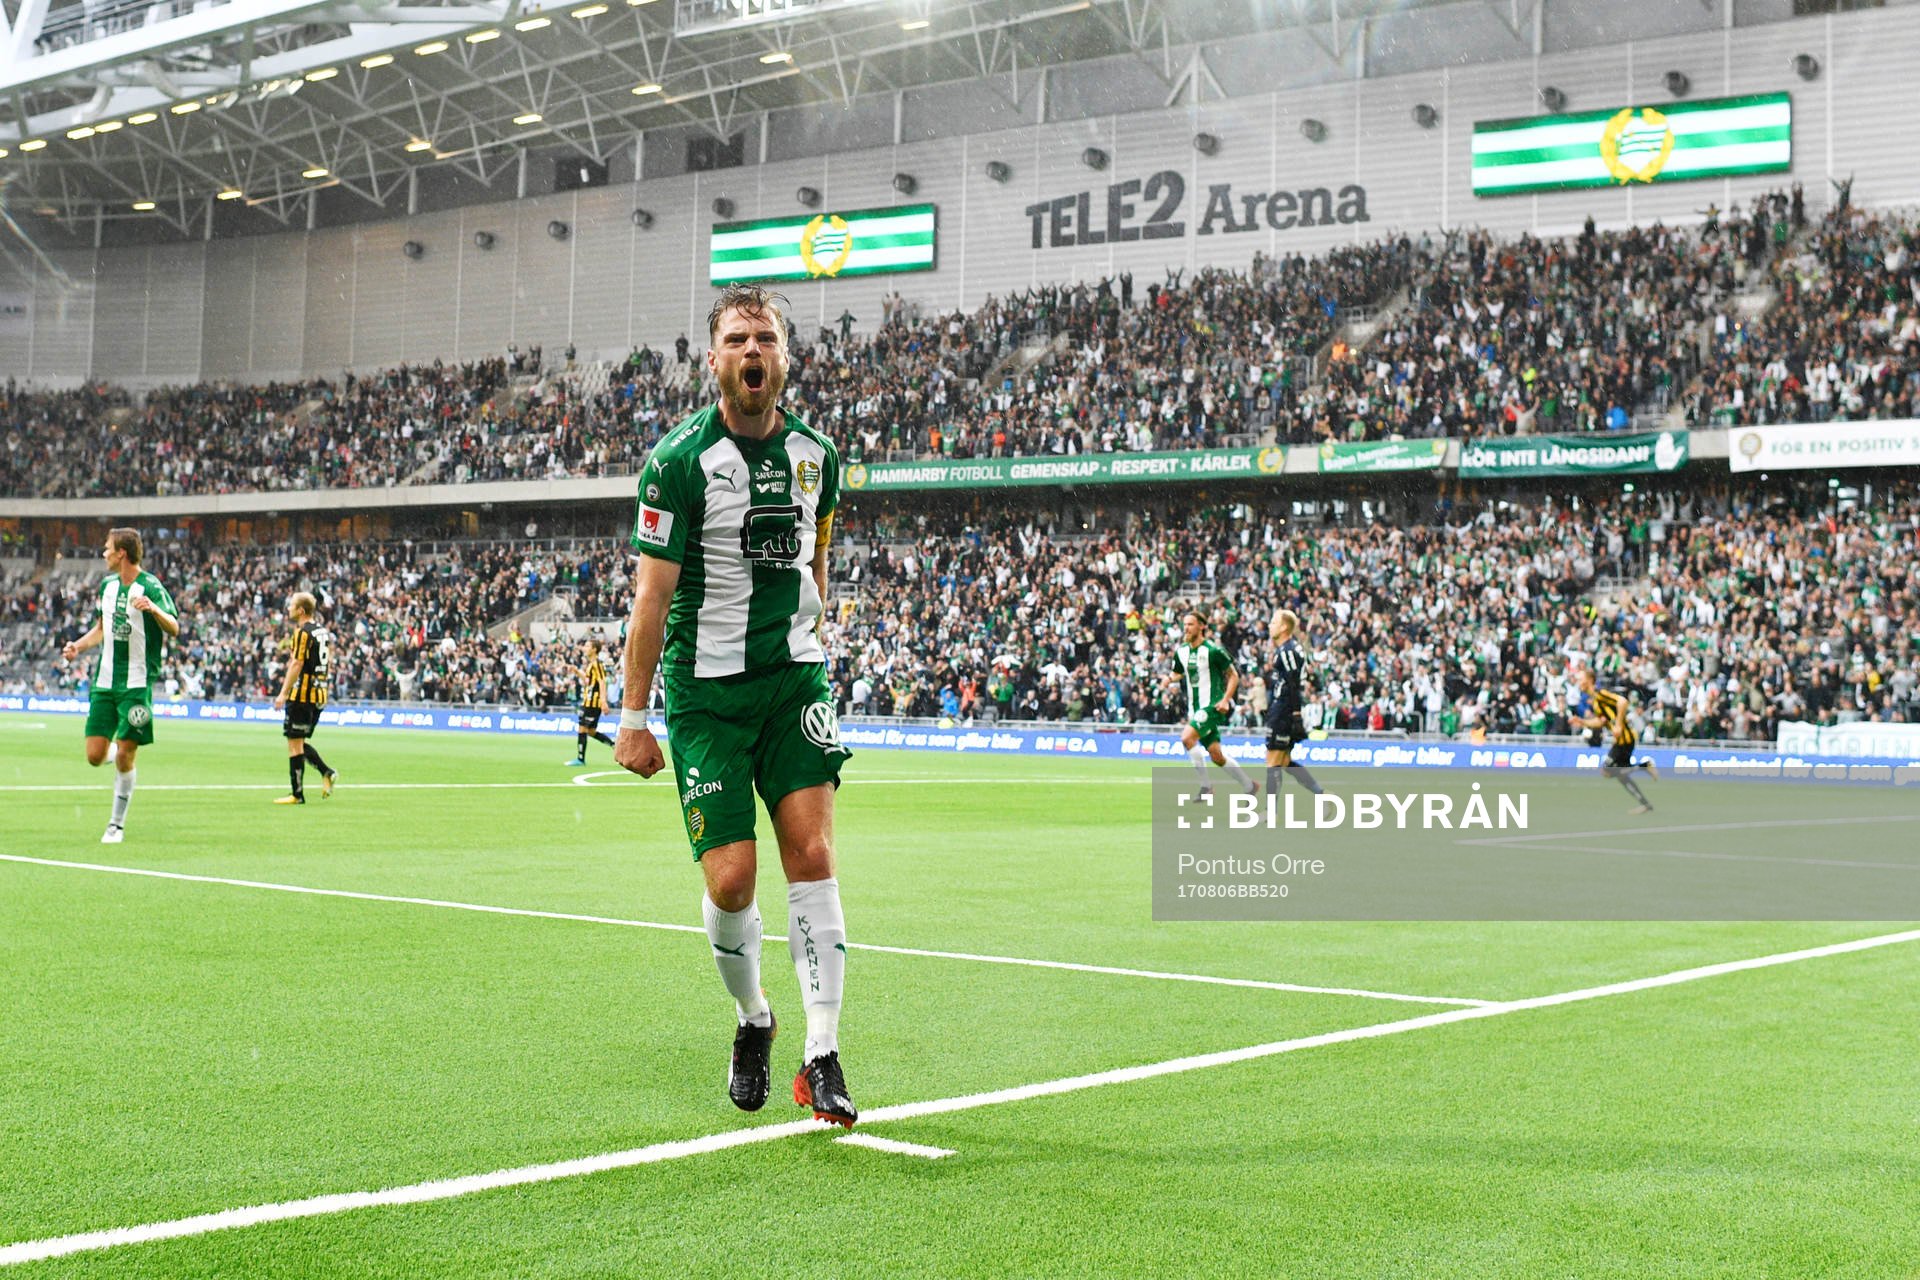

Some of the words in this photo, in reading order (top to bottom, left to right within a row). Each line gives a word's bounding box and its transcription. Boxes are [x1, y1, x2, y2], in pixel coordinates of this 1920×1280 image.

[1025, 170, 1185, 249] TELE2
[1197, 183, 1371, 236] Arena
[1809, 440, 1832, 453] EN
[1837, 438, 1904, 450] POSITIV
[1500, 449, 1538, 467] INTE
[1540, 445, 1650, 465] LÅNGSIDAN!
[755, 470, 786, 480] SAFECON
[870, 468, 949, 484] HAMMARBY
[949, 465, 1003, 482] FOTBOLL
[1010, 461, 1100, 479] GEMENSKAP
[1111, 458, 1179, 475] RESPEKT
[1190, 453, 1252, 473] KÄRLEK
[928, 735, 956, 747] som
[956, 732, 991, 751] gillar
[991, 733, 1023, 750] bilar
[1035, 736, 1098, 752] MEGA
[1121, 739, 1185, 755] MEGA
[1337, 748, 1372, 763] som
[1373, 745, 1416, 767] gillar
[1416, 747, 1455, 766] bilar
[1470, 750, 1547, 767] MEGA
[797, 915, 820, 992] KVARNEN
